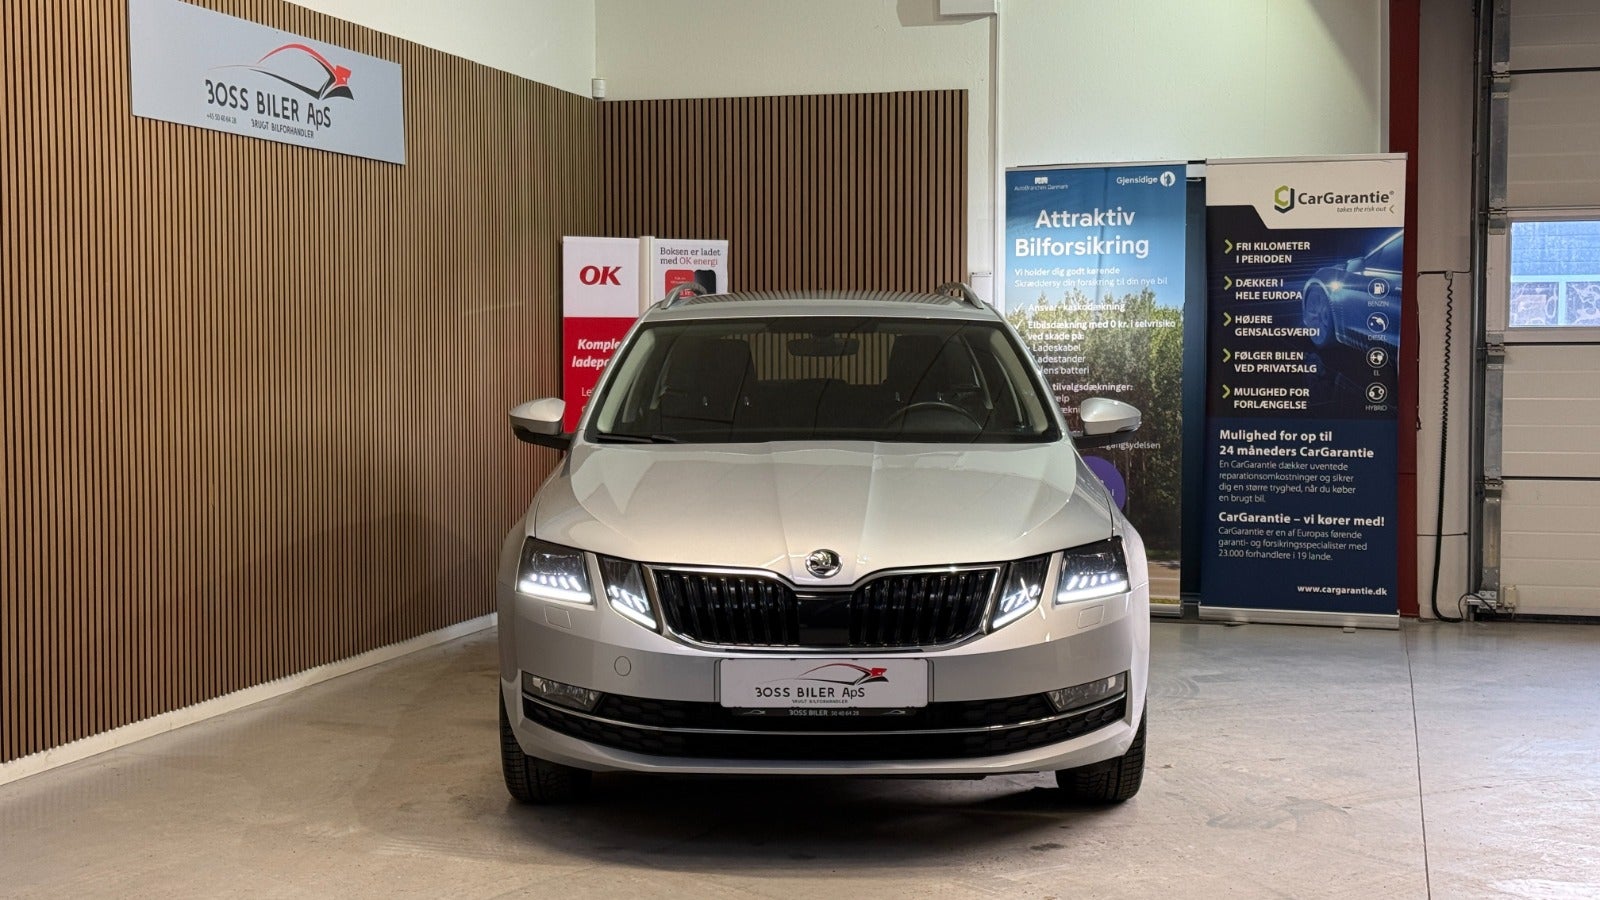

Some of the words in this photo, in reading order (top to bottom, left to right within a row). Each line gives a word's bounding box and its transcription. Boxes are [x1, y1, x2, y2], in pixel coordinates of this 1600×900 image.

[256, 91, 300, 122] BILER
[307, 102, 331, 131] ApS
[271, 125, 314, 139] BILFORHANDLER
[1116, 175, 1158, 185] Gjensidige
[1035, 206, 1136, 228] Attraktiv
[660, 247, 689, 256] Boksen
[701, 248, 721, 256] ladet
[1015, 235, 1149, 259] Bilforsikring
[1236, 242, 1251, 251] FRI
[1253, 241, 1311, 251] KILOMETER
[660, 257, 678, 265] med
[679, 257, 692, 265] OK
[693, 257, 718, 267] energi
[1241, 254, 1292, 264] PERIODEN
[579, 265, 622, 286] OK
[1014, 268, 1023, 276] Vi
[1024, 267, 1049, 277] holder
[1051, 267, 1065, 277] dig
[1066, 267, 1085, 277] godt
[1086, 266, 1120, 275] kørende
[1063, 278, 1076, 287] din
[1077, 278, 1114, 288] forsikring
[1116, 277, 1126, 286] til
[1127, 277, 1139, 286] din
[1141, 278, 1156, 287] nye
[1157, 276, 1168, 285] bil
[1235, 278, 1278, 287] DÆKKER
[1235, 291, 1261, 300] HELE
[1262, 291, 1303, 300] EUROPA
[1028, 320, 1088, 331] Elbilsdækning
[1088, 320, 1108, 329] med
[1110, 320, 1116, 329] 0
[1117, 320, 1129, 329] kr.
[1134, 319, 1175, 328] selvrisiko
[1234, 315, 1273, 324] HØJERE
[1044, 332, 1070, 340] skade
[1234, 327, 1320, 337] GENSALGSVÆRDI
[577, 338, 620, 353] Komple
[1033, 343, 1081, 352] Ladeskabel
[1234, 351, 1273, 361] FØLGER
[1275, 351, 1304, 360] BILEN
[1061, 365, 1090, 375] batteri
[1234, 364, 1255, 373] VED
[1256, 364, 1317, 373] PRIVATSALG
[1052, 382, 1133, 393] tilvalgsdækninger:
[1233, 387, 1287, 397] MULIGHED
[1289, 387, 1310, 397] FOR
[1233, 400, 1308, 410] FORLÆNGELSE
[1219, 430, 1277, 442] Mulighed
[1279, 430, 1298, 441] for
[1300, 433, 1317, 443] op
[1319, 431, 1333, 442] til
[1219, 445, 1234, 455] 24
[1237, 444, 1297, 456] måneders
[1299, 446, 1374, 458] CarGarantie
[1219, 460, 1229, 468] En
[1230, 460, 1277, 469] CarGarantie
[1278, 461, 1308, 470] dækker
[1309, 462, 1348, 471] uventede
[1219, 472, 1318, 483] reparationsomkostninger
[1319, 474, 1330, 483] og
[1332, 474, 1354, 482] sikrer
[1218, 483, 1232, 493] dig
[1245, 484, 1268, 492] større
[1269, 484, 1303, 494] tryghed,
[1304, 484, 1318, 493] når
[1319, 485, 1330, 493] du
[1332, 485, 1356, 494] køber
[1230, 494, 1253, 504] brugt
[1254, 494, 1266, 503] bil.
[1218, 511, 1291, 523] CarGarantie
[1303, 514, 1315, 524] vi
[1317, 514, 1350, 525] kører
[1353, 515, 1385, 527] med!
[1218, 527, 1264, 536] CarGarantie
[1287, 528, 1296, 537] af
[1297, 529, 1329, 539] Europas
[1330, 530, 1362, 539] førende
[1218, 538, 1249, 548] garanti-
[1250, 540, 1261, 549] og
[1262, 539, 1347, 550] forsikringsspecialister
[1348, 541, 1368, 550] med
[1218, 549, 1244, 558] 23.000
[1245, 550, 1291, 560] forhandlere
[1297, 551, 1307, 560] 19
[1308, 552, 1333, 561] lande.
[1297, 584, 1388, 596] www.cargarantie.dk
[797, 687, 835, 698] BILER
[842, 687, 866, 700] ApS
